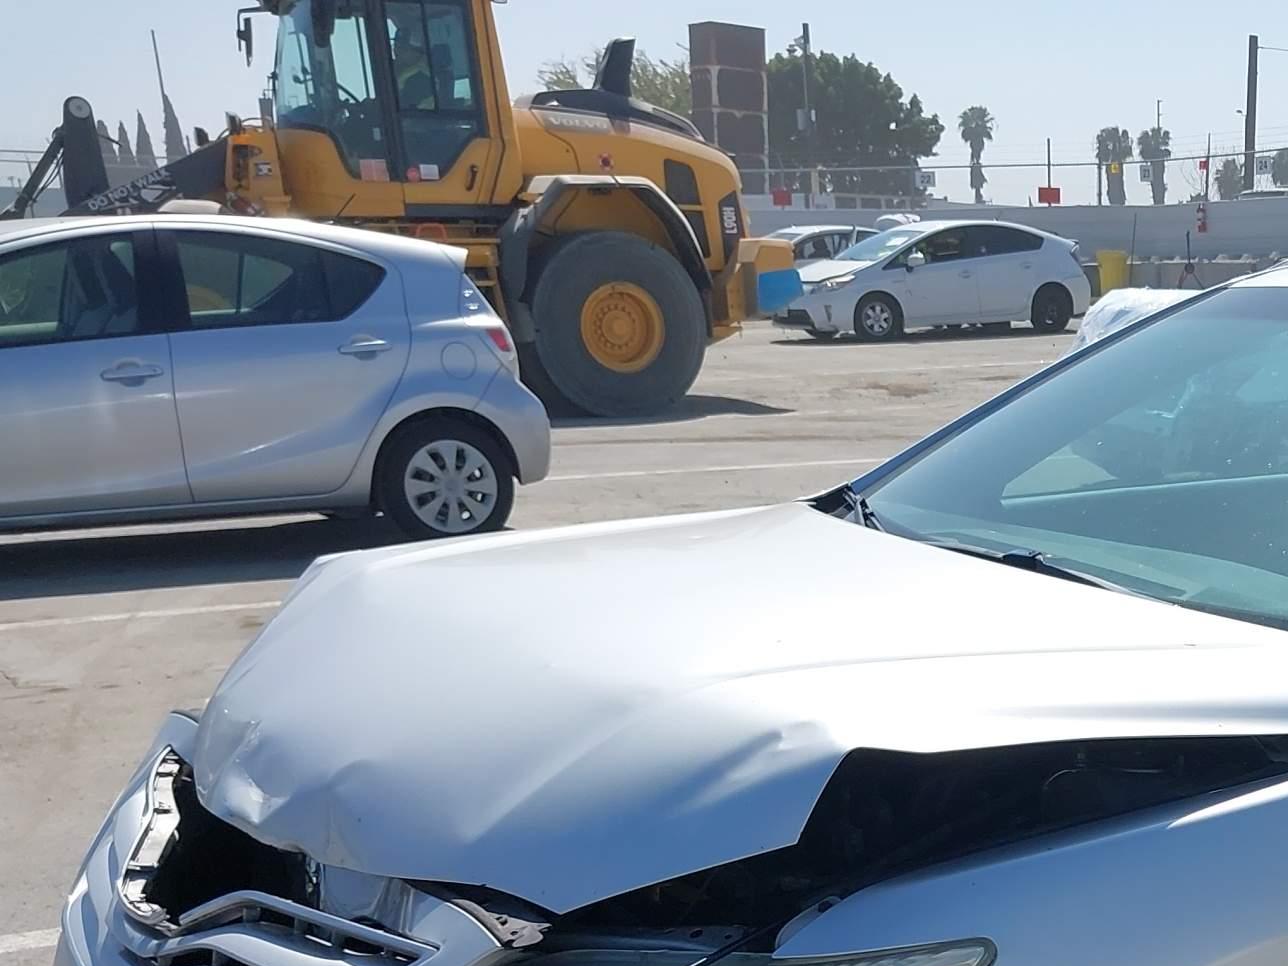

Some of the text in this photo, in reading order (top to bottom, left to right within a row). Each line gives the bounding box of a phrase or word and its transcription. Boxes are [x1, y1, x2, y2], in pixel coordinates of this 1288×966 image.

[547, 115, 609, 130] VOLVO
[87, 167, 171, 211] DO NOT WALK
